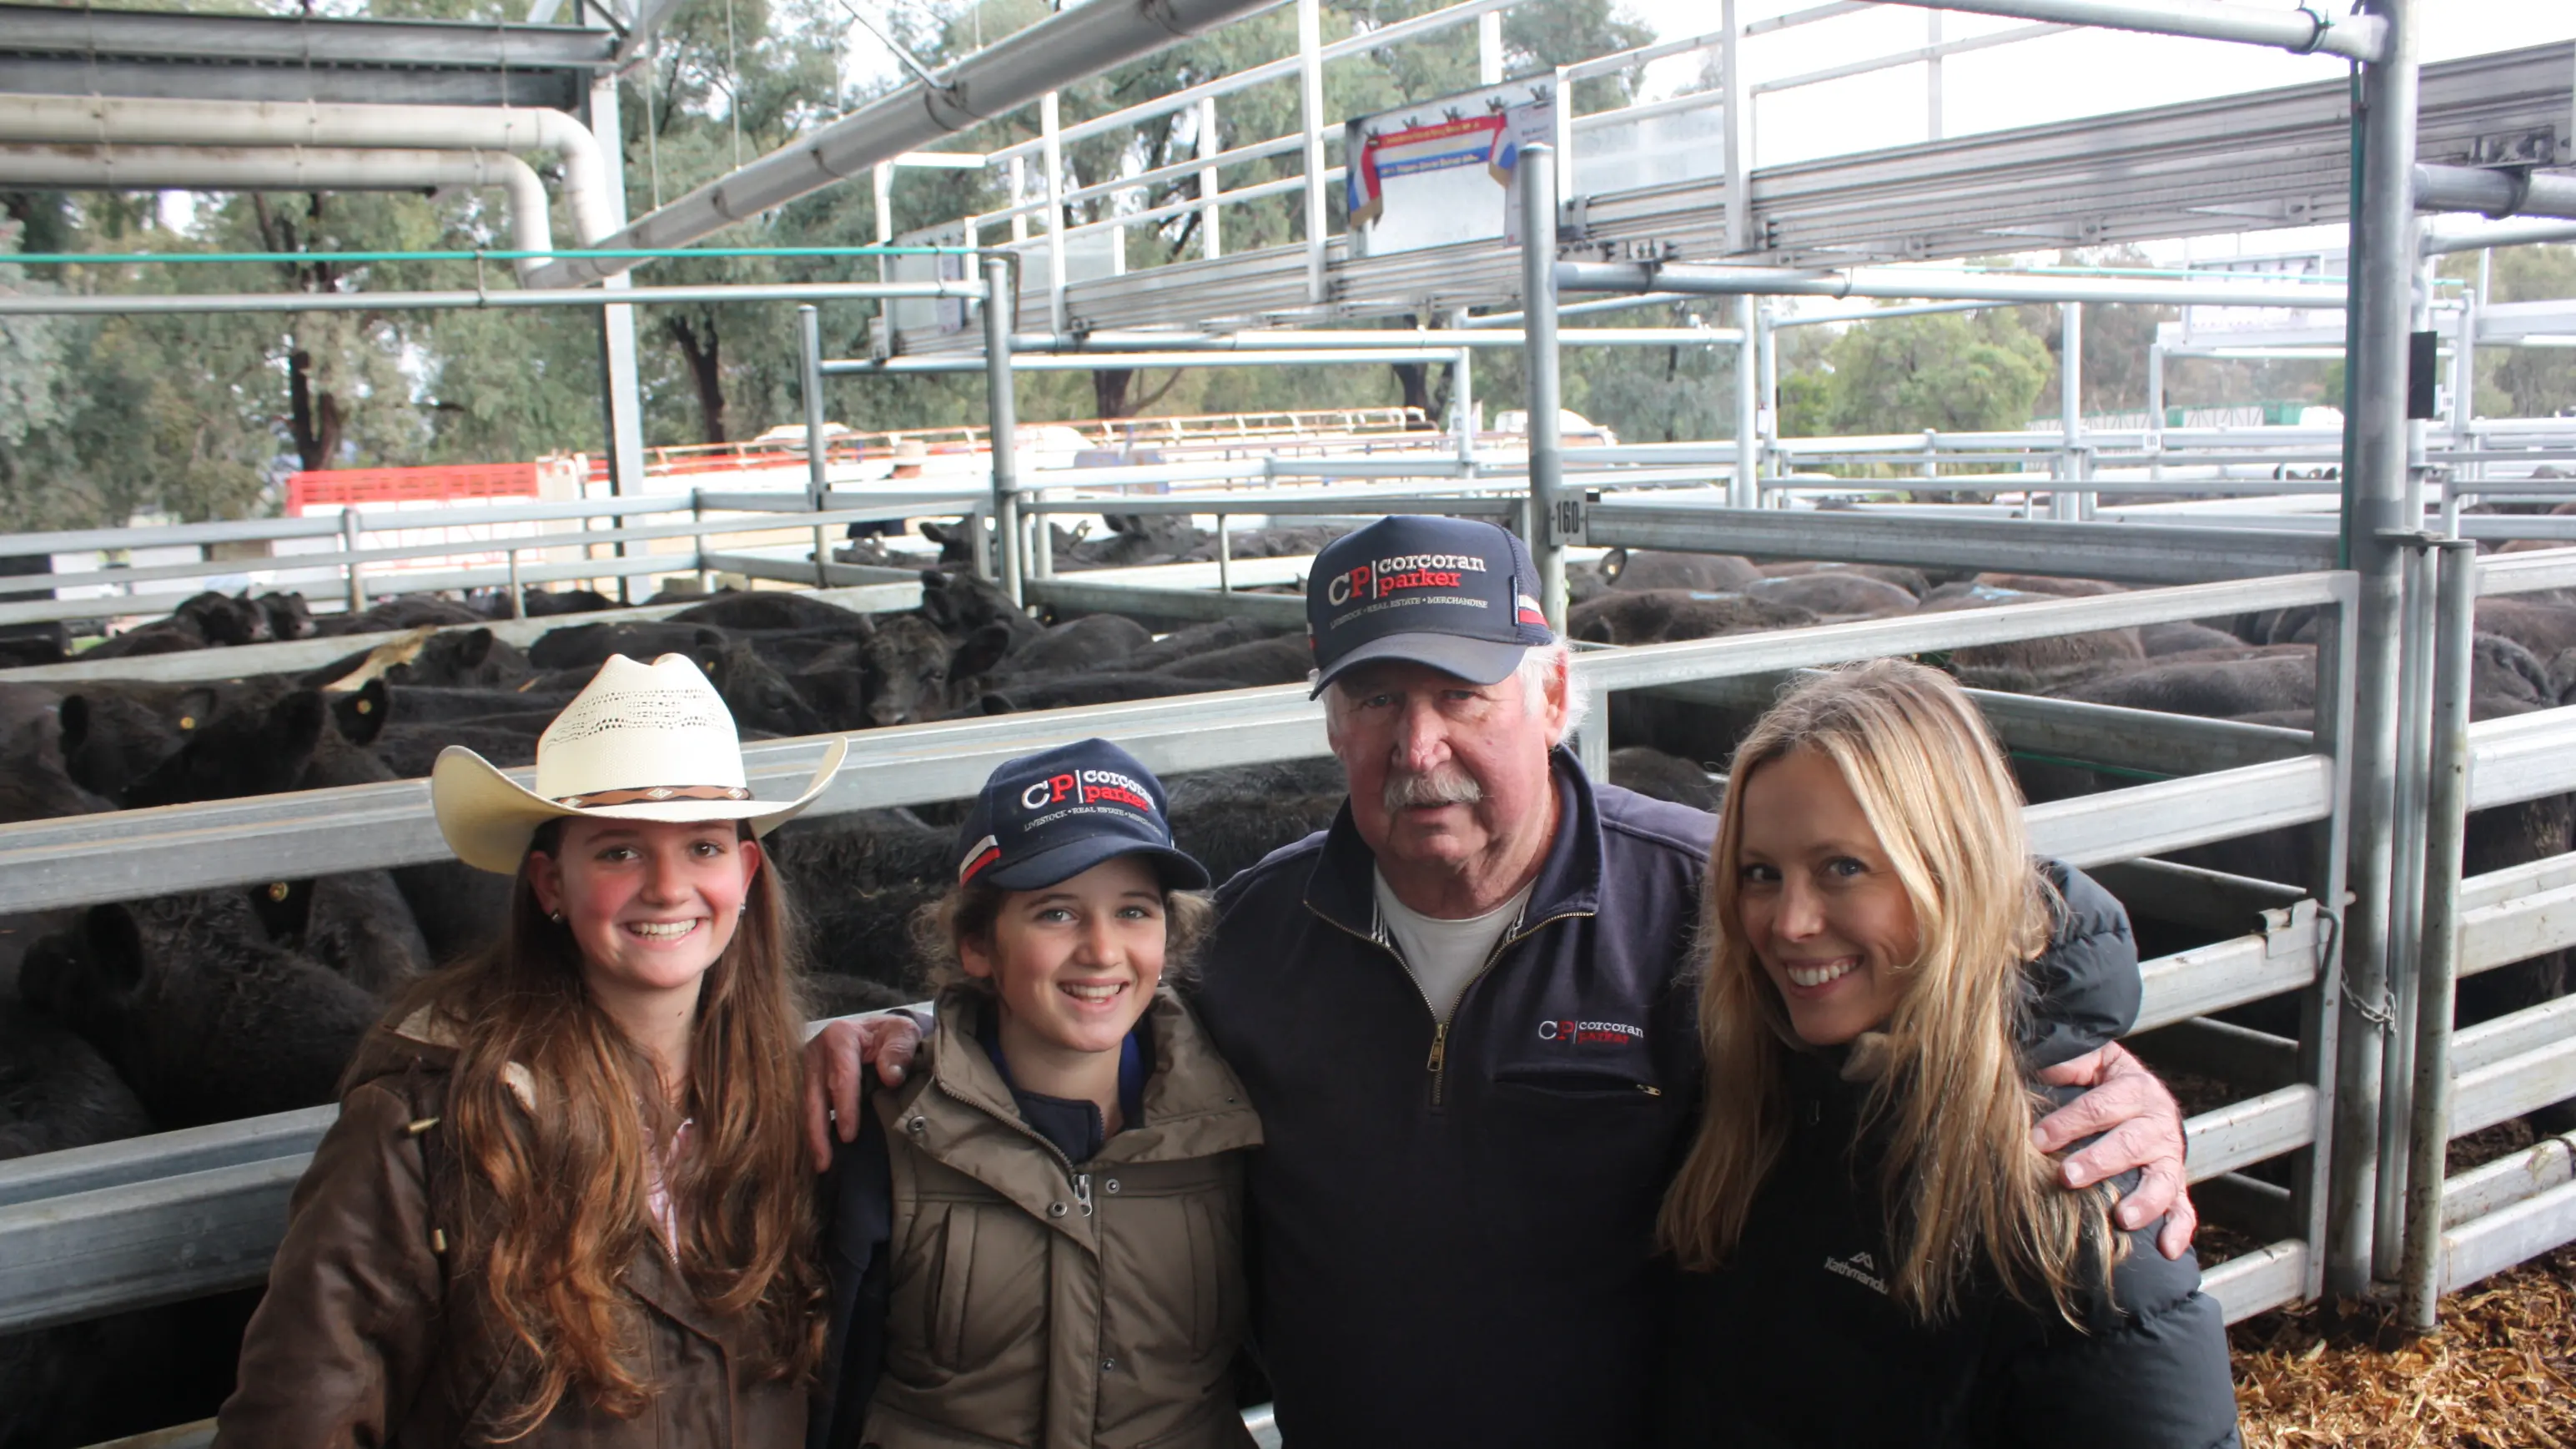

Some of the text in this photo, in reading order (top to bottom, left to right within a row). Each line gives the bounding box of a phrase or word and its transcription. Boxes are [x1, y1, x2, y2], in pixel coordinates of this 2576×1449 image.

[1556, 501, 1579, 534] 160
[1328, 554, 1487, 606] CP corcoran
[1378, 569, 1462, 598] parker
[1390, 597, 1421, 607] ESTATE
[1427, 596, 1488, 609] MERCHANDISE
[1022, 774, 1074, 809] CP
[1084, 785, 1149, 812] parker
[1024, 809, 1068, 832] LIVESTOCK
[1097, 807, 1124, 816] ESTATE
[1538, 1020, 1644, 1040] CP corcoran
